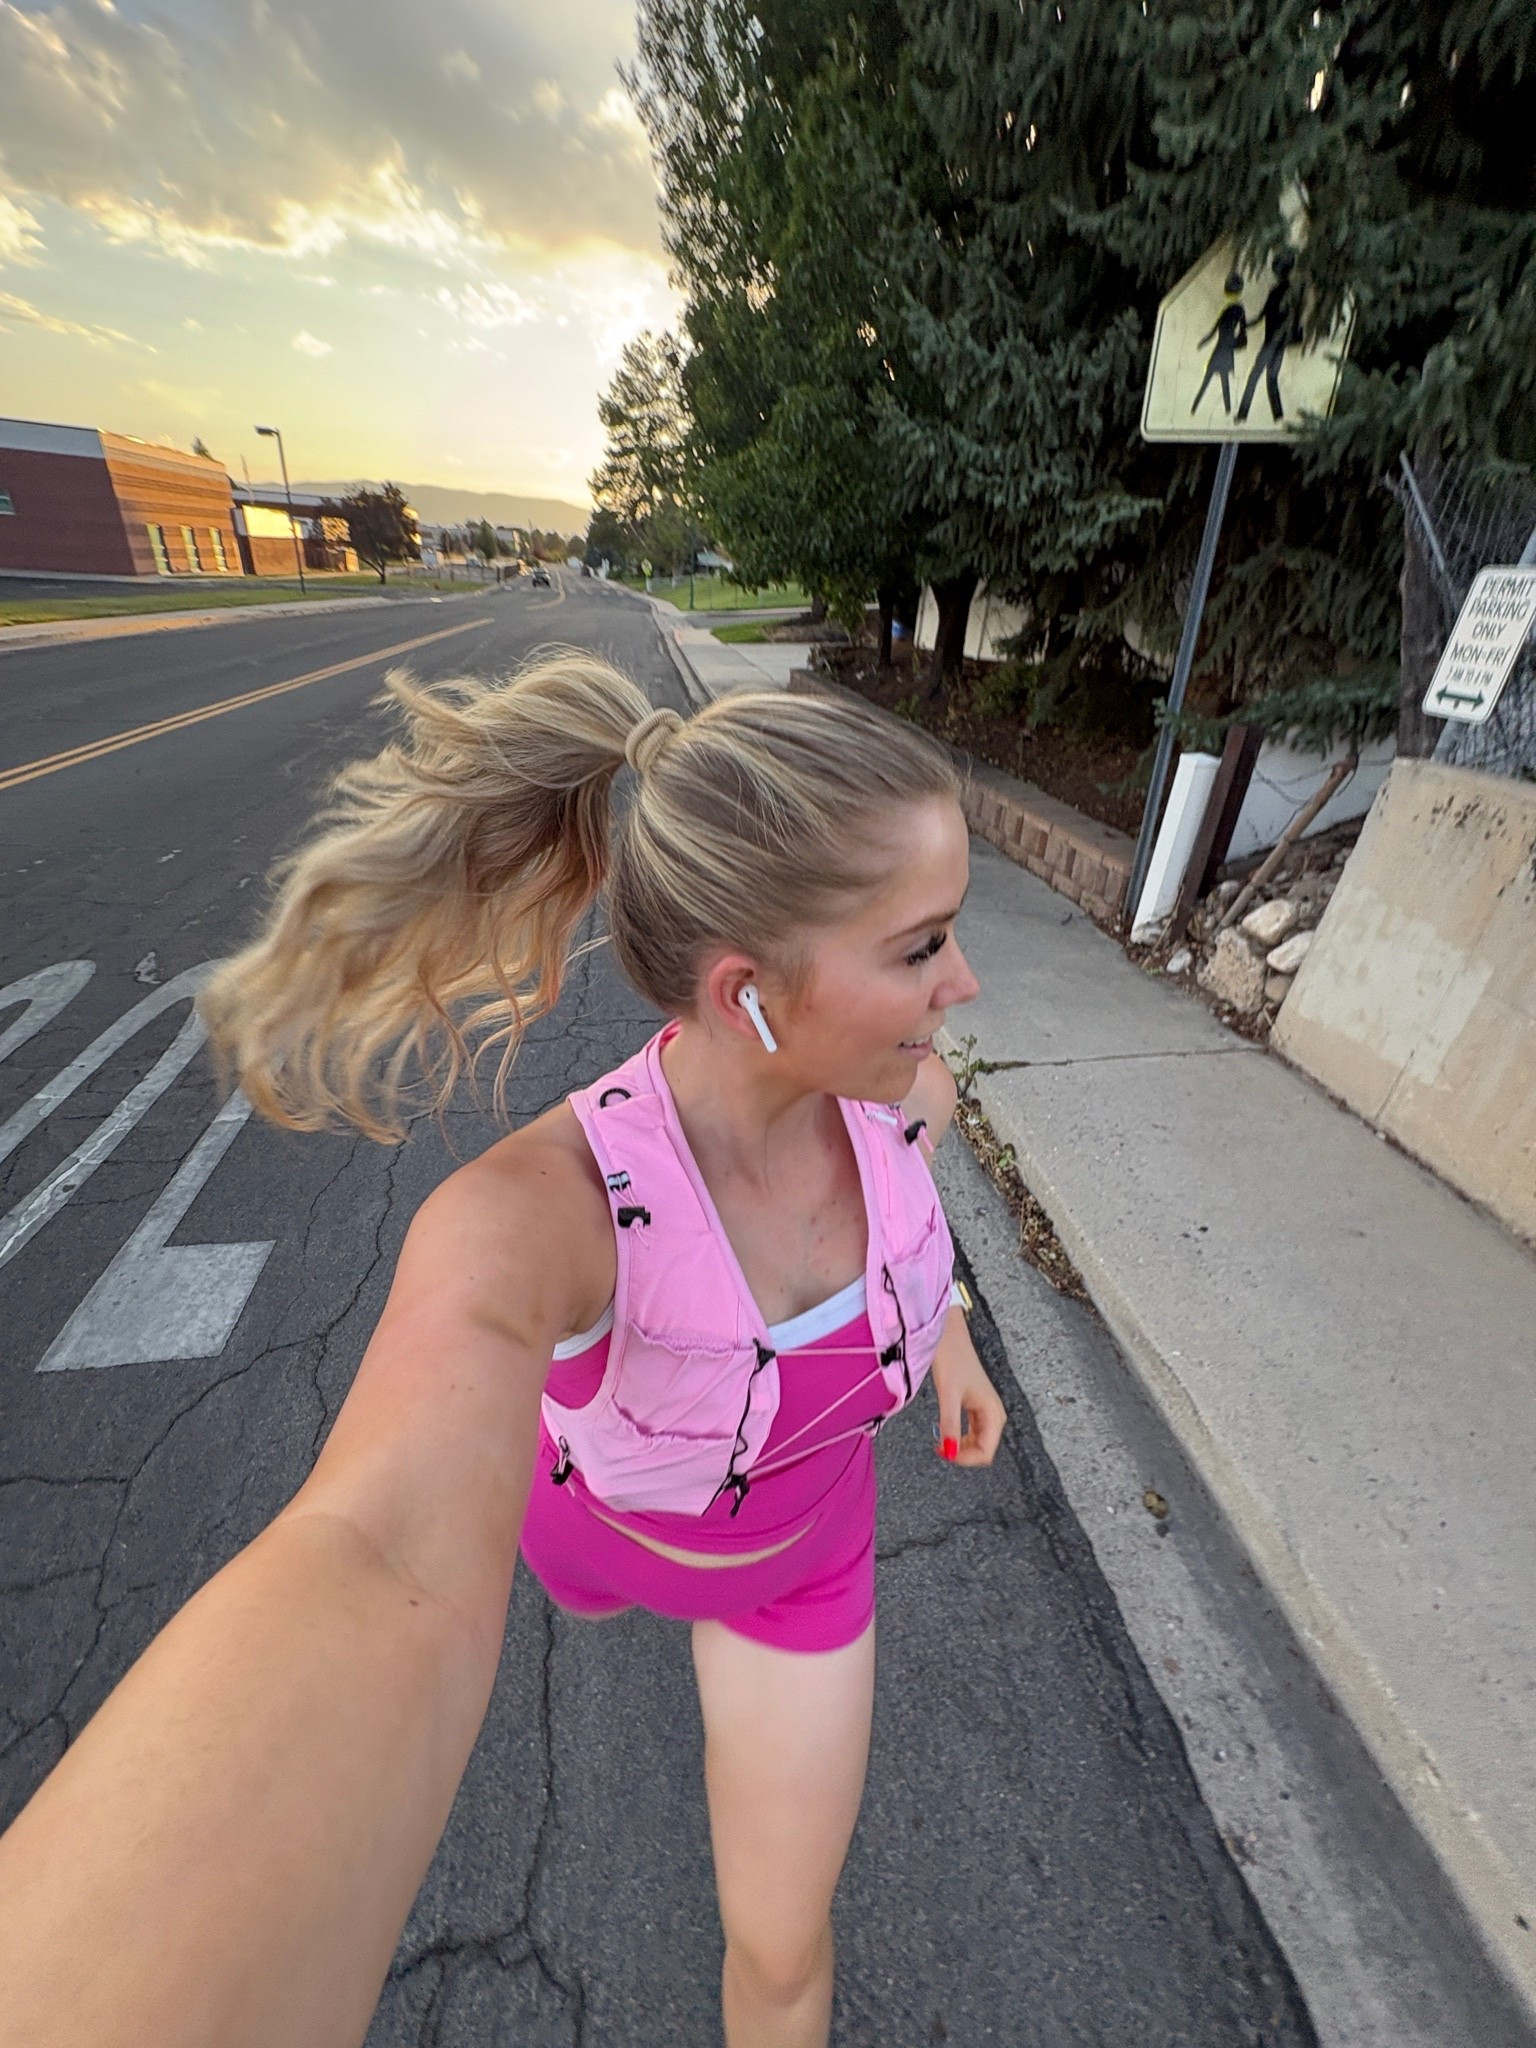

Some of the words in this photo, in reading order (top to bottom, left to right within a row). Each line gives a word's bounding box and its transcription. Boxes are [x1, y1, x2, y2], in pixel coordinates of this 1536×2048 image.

[1481, 576, 1536, 598] PERMIT
[1468, 597, 1531, 622] PARKING
[1472, 620, 1507, 641] ONLY
